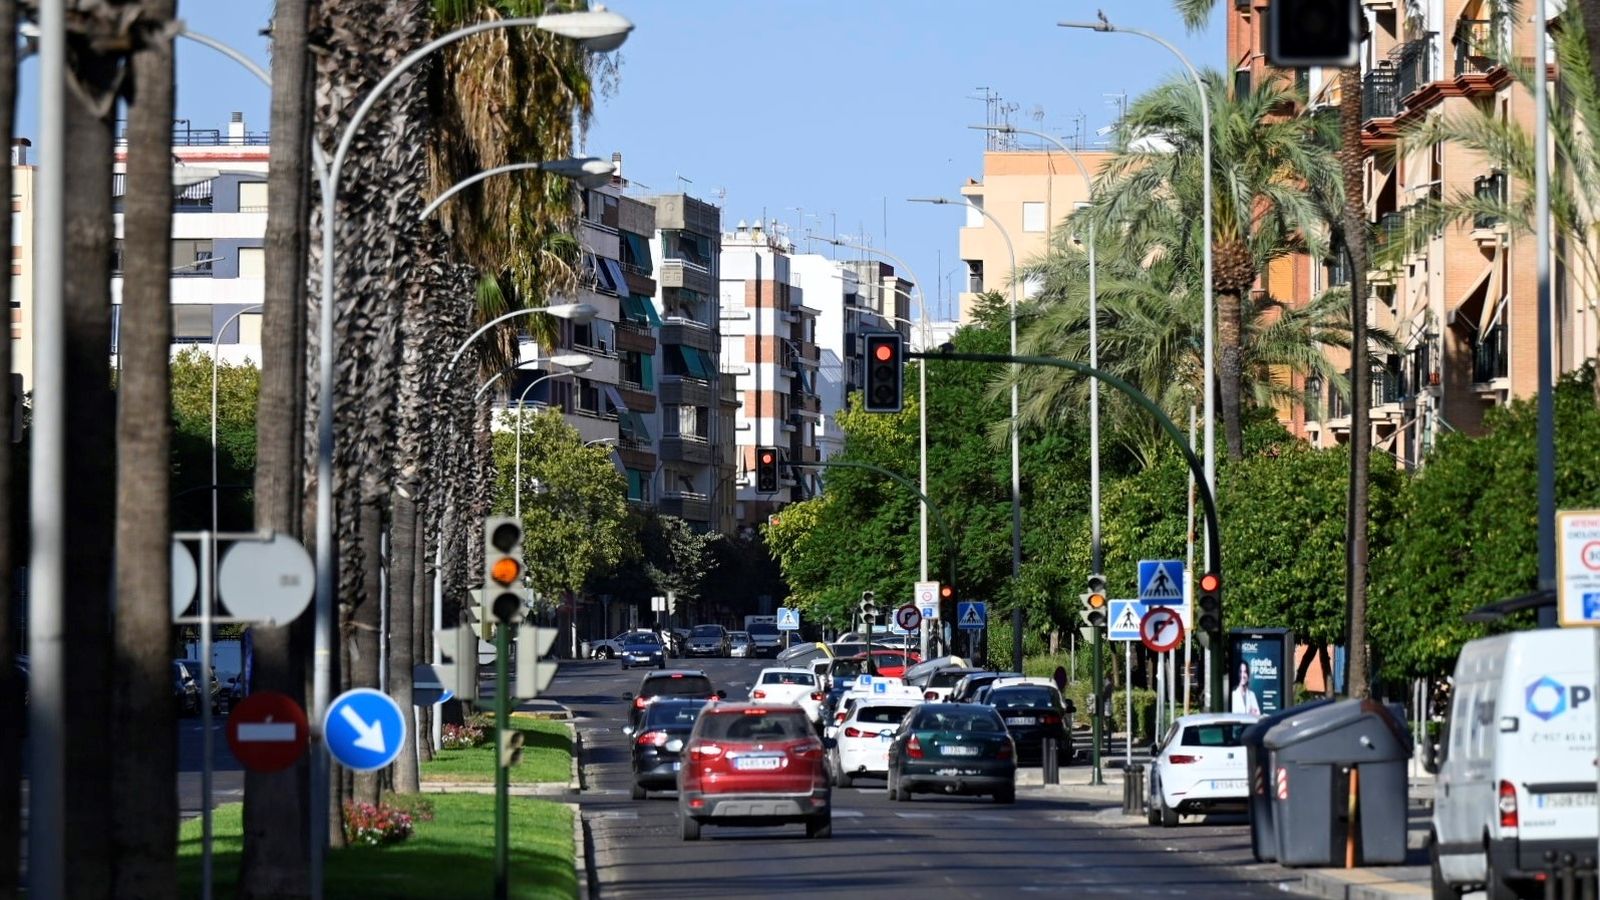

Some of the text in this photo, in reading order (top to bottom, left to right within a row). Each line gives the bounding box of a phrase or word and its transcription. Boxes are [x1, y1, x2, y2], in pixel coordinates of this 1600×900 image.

[1251, 658, 1272, 666] Estudia
[1250, 666, 1277, 675] FP Oficial
